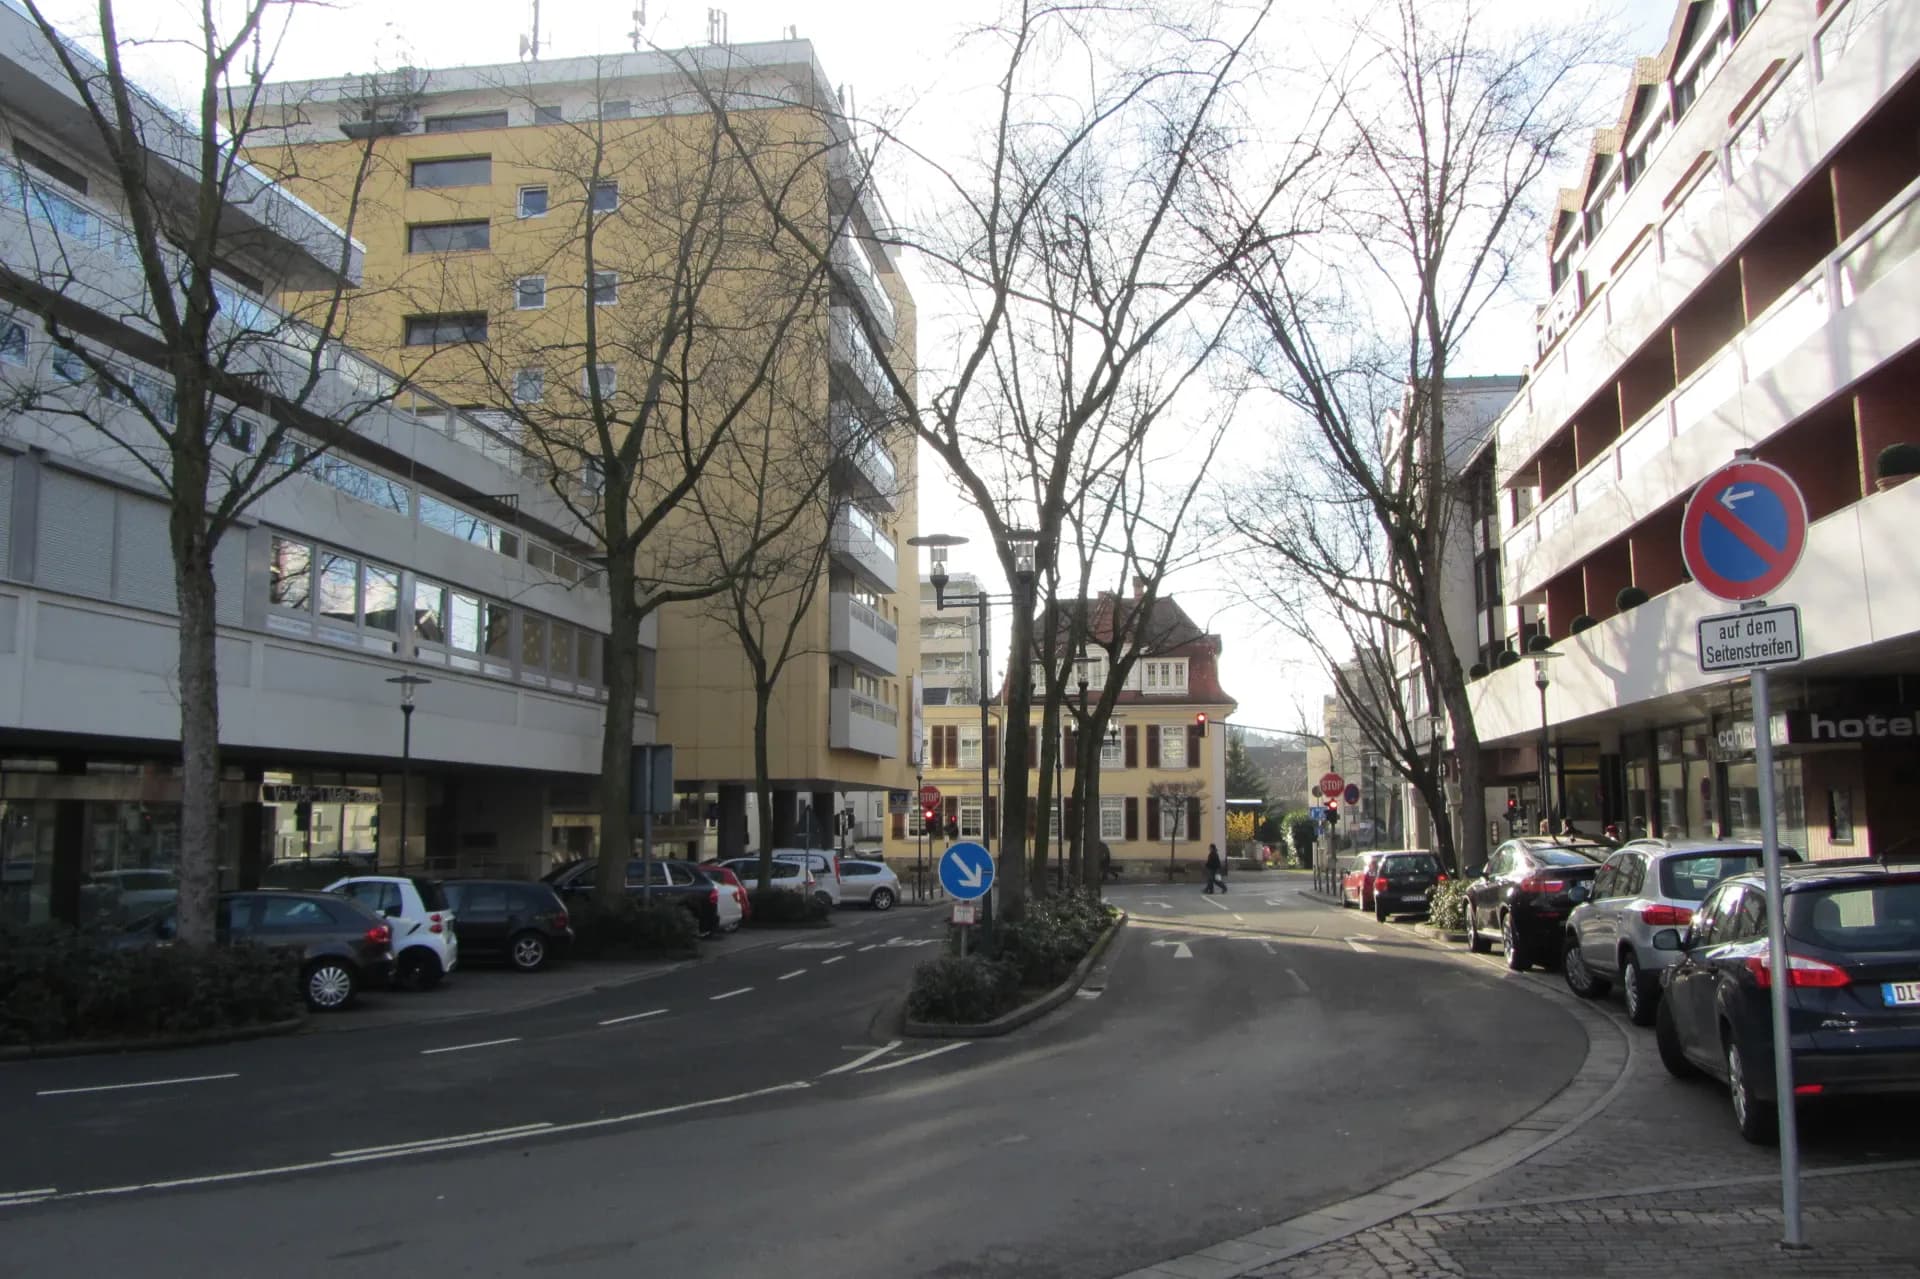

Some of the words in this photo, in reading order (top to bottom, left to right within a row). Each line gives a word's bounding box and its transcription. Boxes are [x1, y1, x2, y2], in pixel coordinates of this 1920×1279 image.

[1719, 621, 1741, 640] auf
[1746, 618, 1777, 637] dem
[1706, 638, 1793, 664] Seitenstreifen
[1718, 715, 1786, 748] concde
[1810, 709, 1920, 739] hotel
[920, 791, 939, 802] STOP
[1322, 780, 1343, 791] STOP
